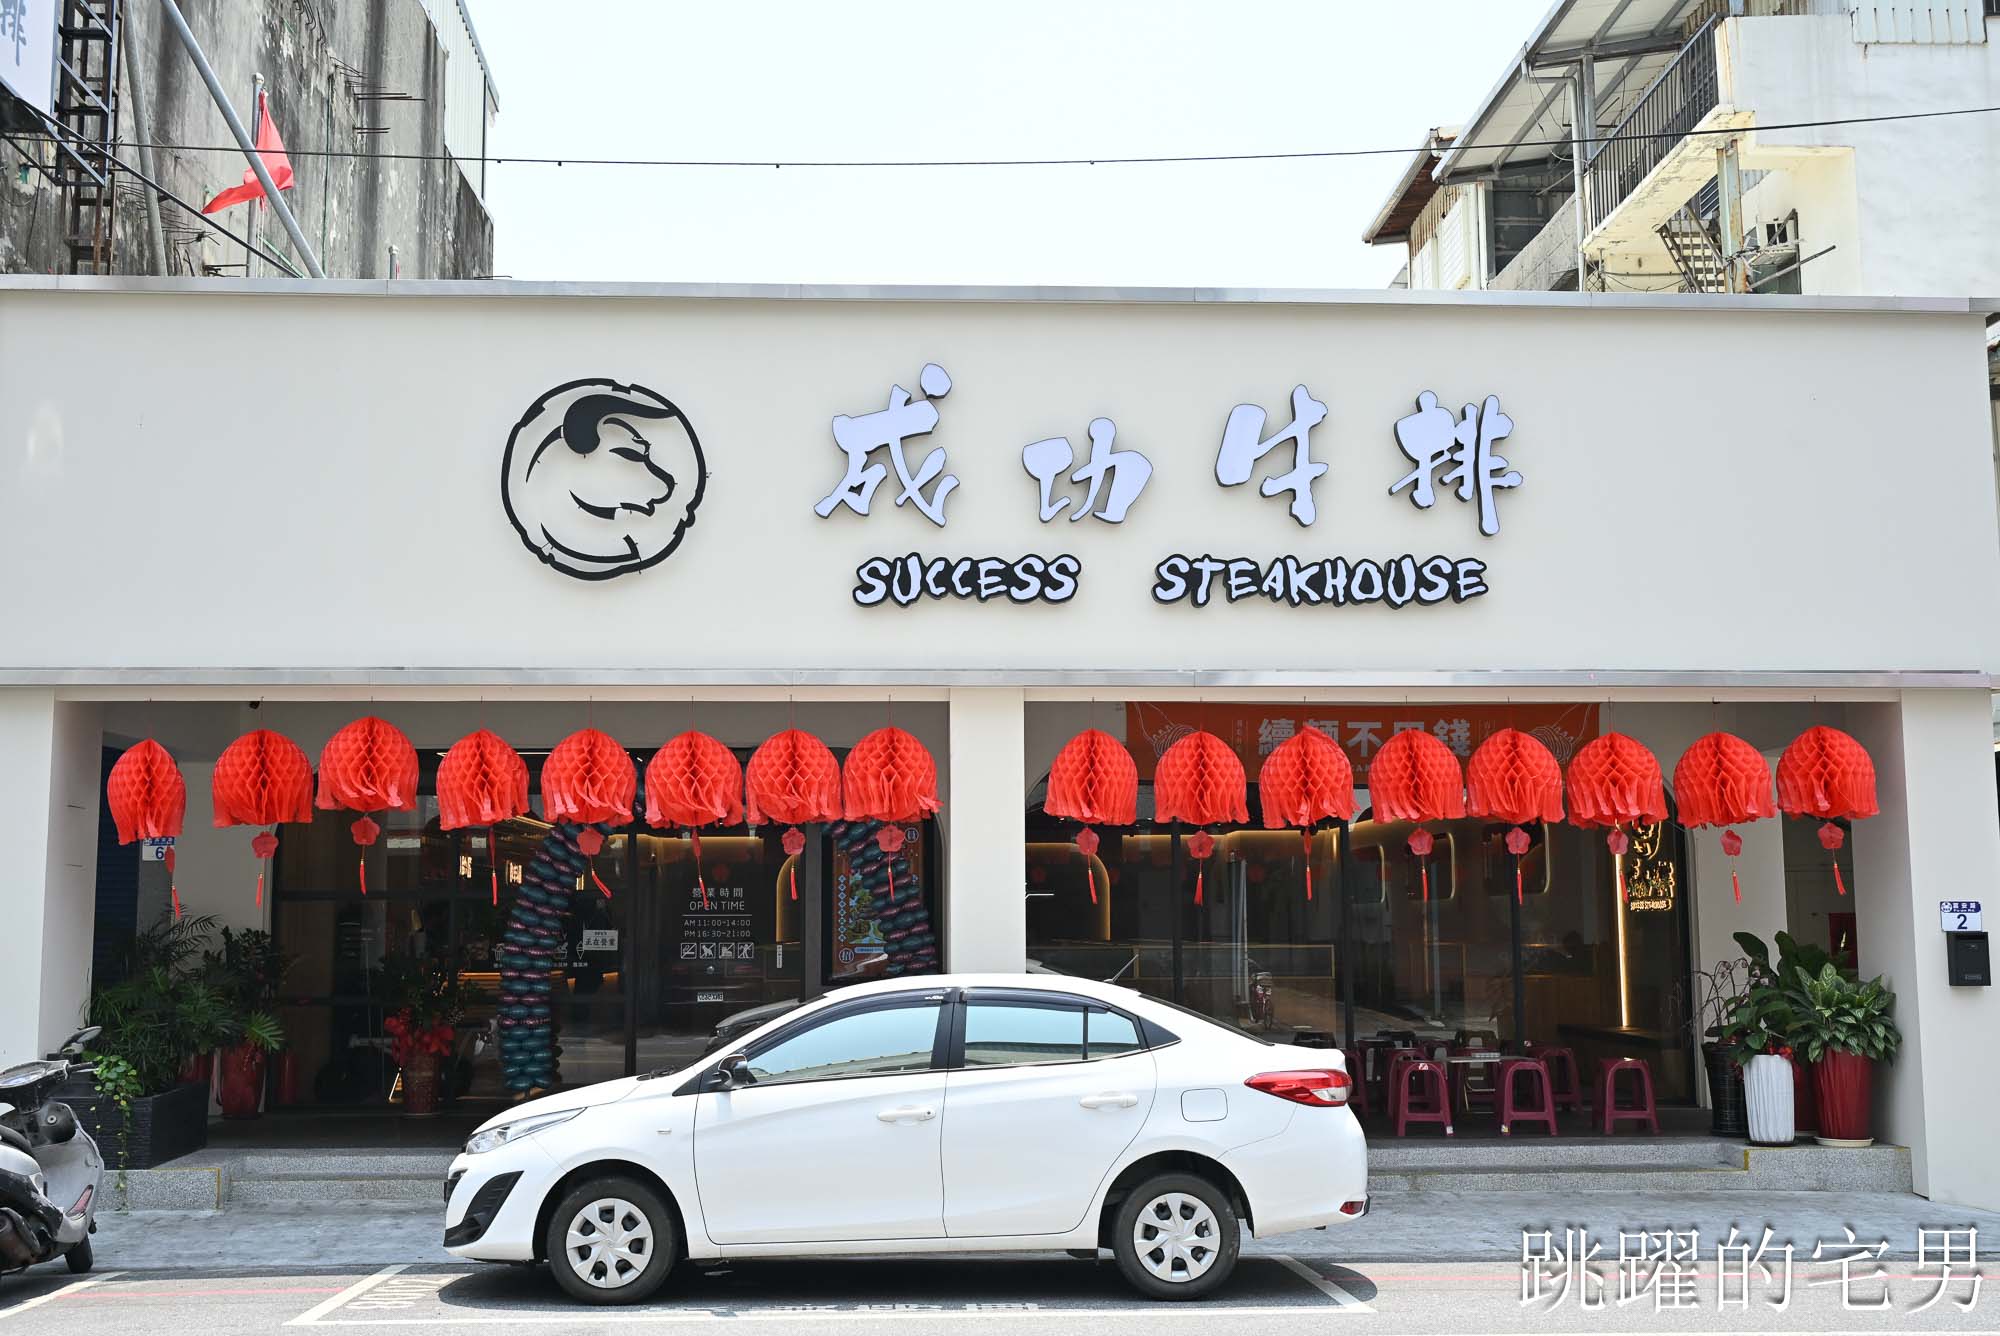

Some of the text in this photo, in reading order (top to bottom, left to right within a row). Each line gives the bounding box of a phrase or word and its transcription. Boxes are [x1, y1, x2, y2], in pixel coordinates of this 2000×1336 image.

[814, 363, 1524, 538] 成功牛排
[853, 552, 1489, 611] SUCCESS STEAKHOUSE
[155, 846, 165, 860] 6
[692, 887, 743, 898] 營業時間
[689, 901, 745, 911] OPEN TIME
[1957, 913, 1968, 930] 2
